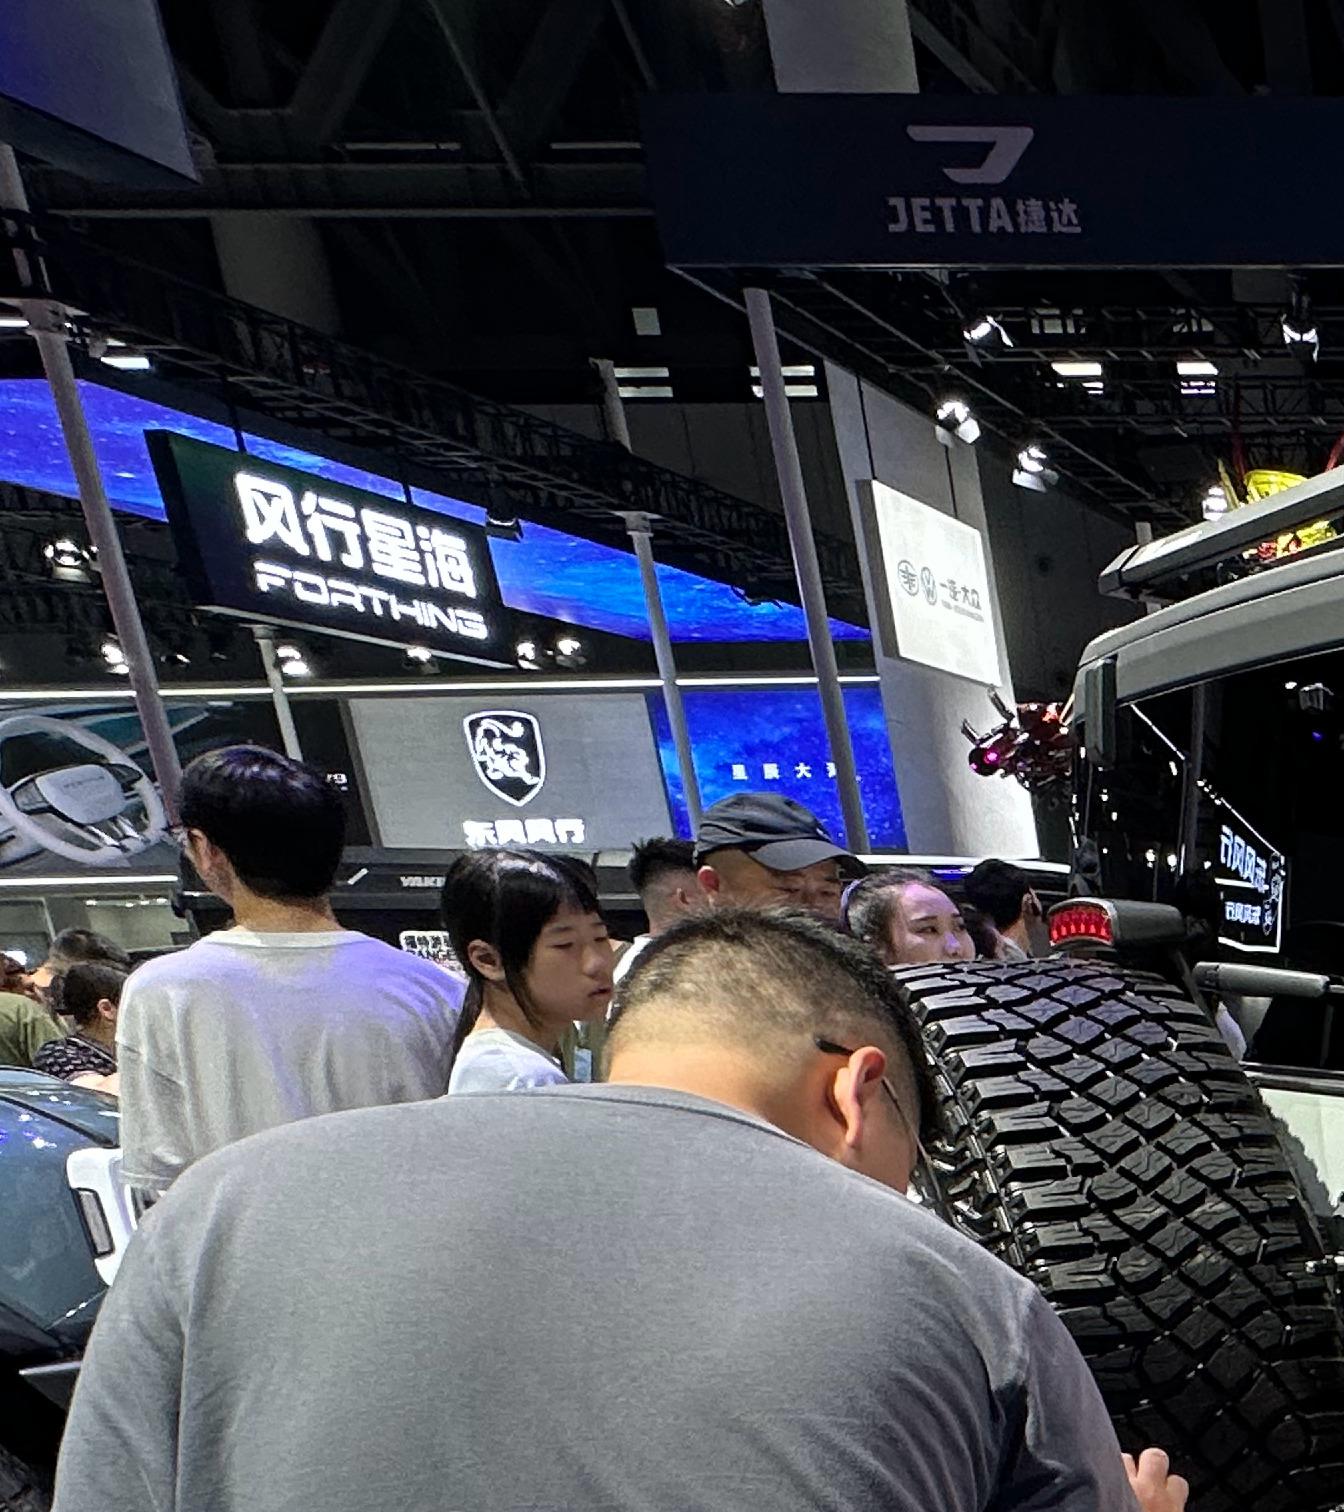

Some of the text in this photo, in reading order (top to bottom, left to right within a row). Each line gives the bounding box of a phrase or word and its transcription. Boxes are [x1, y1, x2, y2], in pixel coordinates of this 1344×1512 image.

[887, 197, 1082, 234] JETTA捷达
[235, 472, 477, 599] 风行星海
[254, 560, 488, 640] FORTHING
